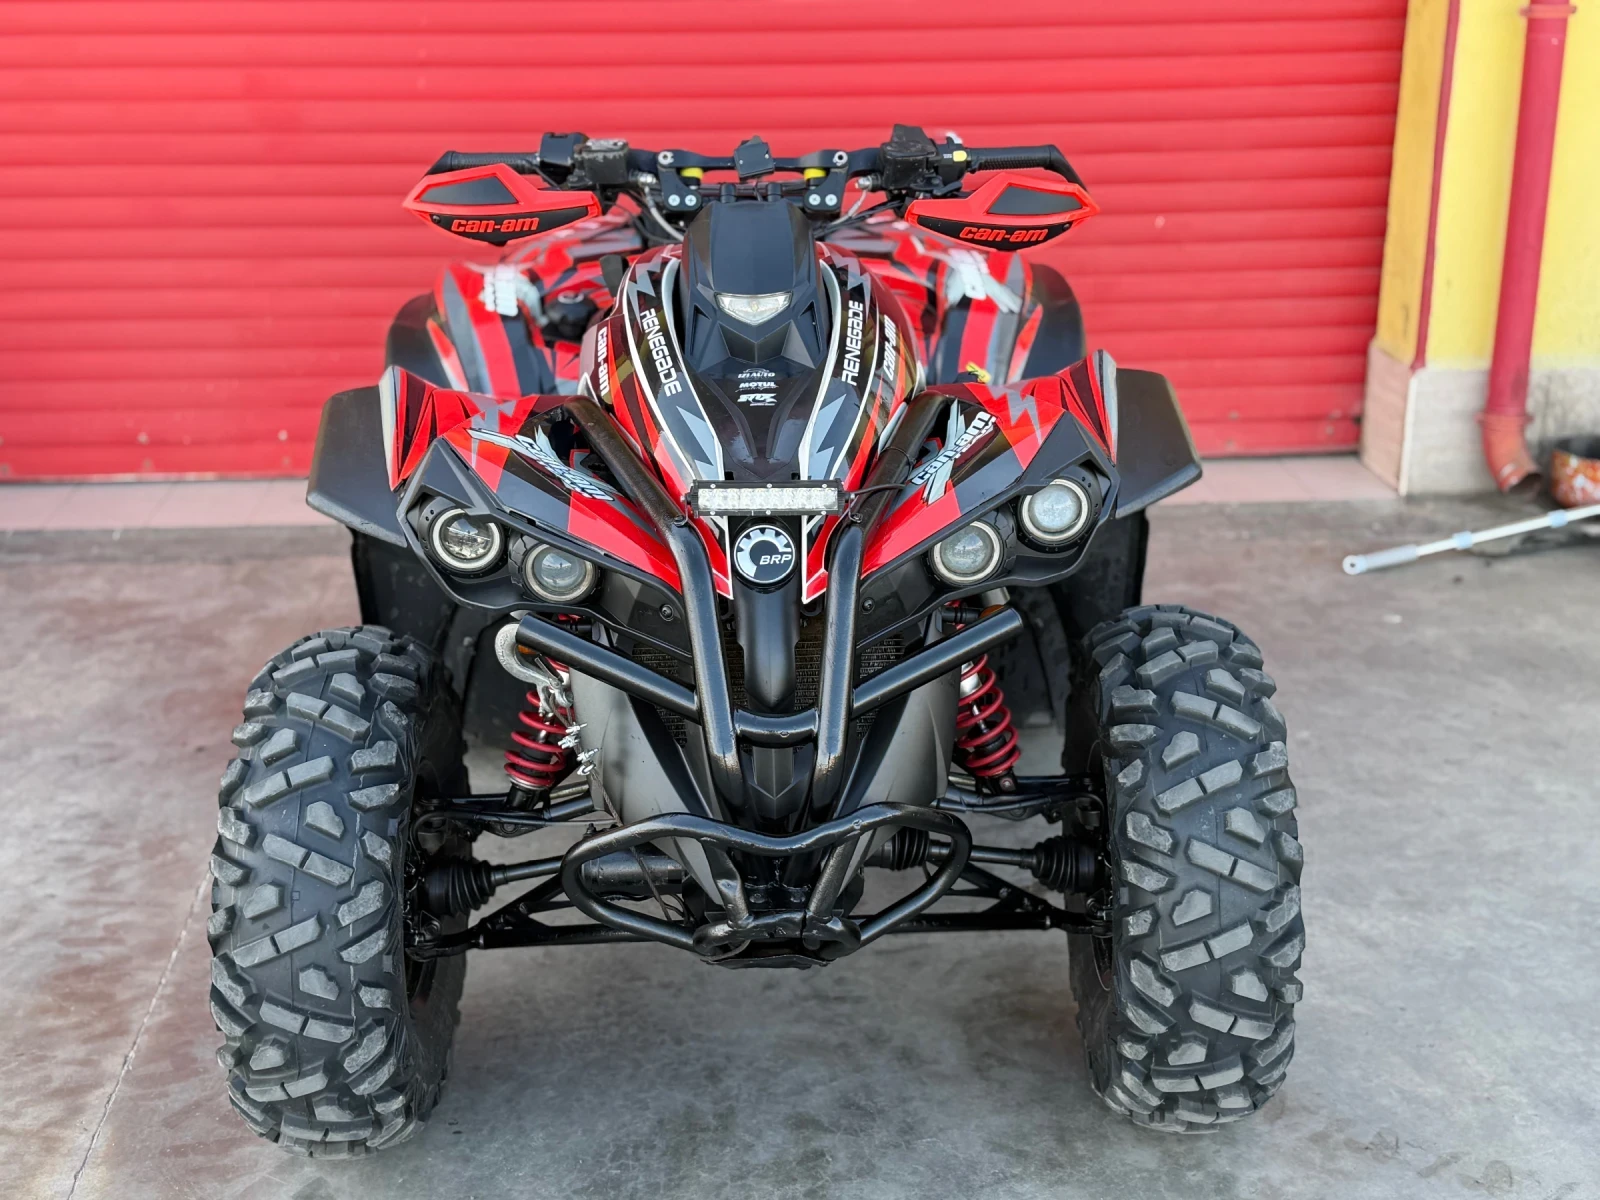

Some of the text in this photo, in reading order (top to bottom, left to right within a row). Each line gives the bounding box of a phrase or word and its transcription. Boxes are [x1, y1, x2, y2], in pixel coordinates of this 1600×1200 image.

[451, 217, 539, 233] can-am
[959, 226, 1048, 242] can-am
[597, 326, 610, 397] can-am
[640, 308, 682, 397] RENEGADE
[841, 300, 863, 386] RENEGADE
[883, 314, 897, 381] can-am
[911, 411, 997, 485] can-am
[759, 554, 792, 565] BRP
